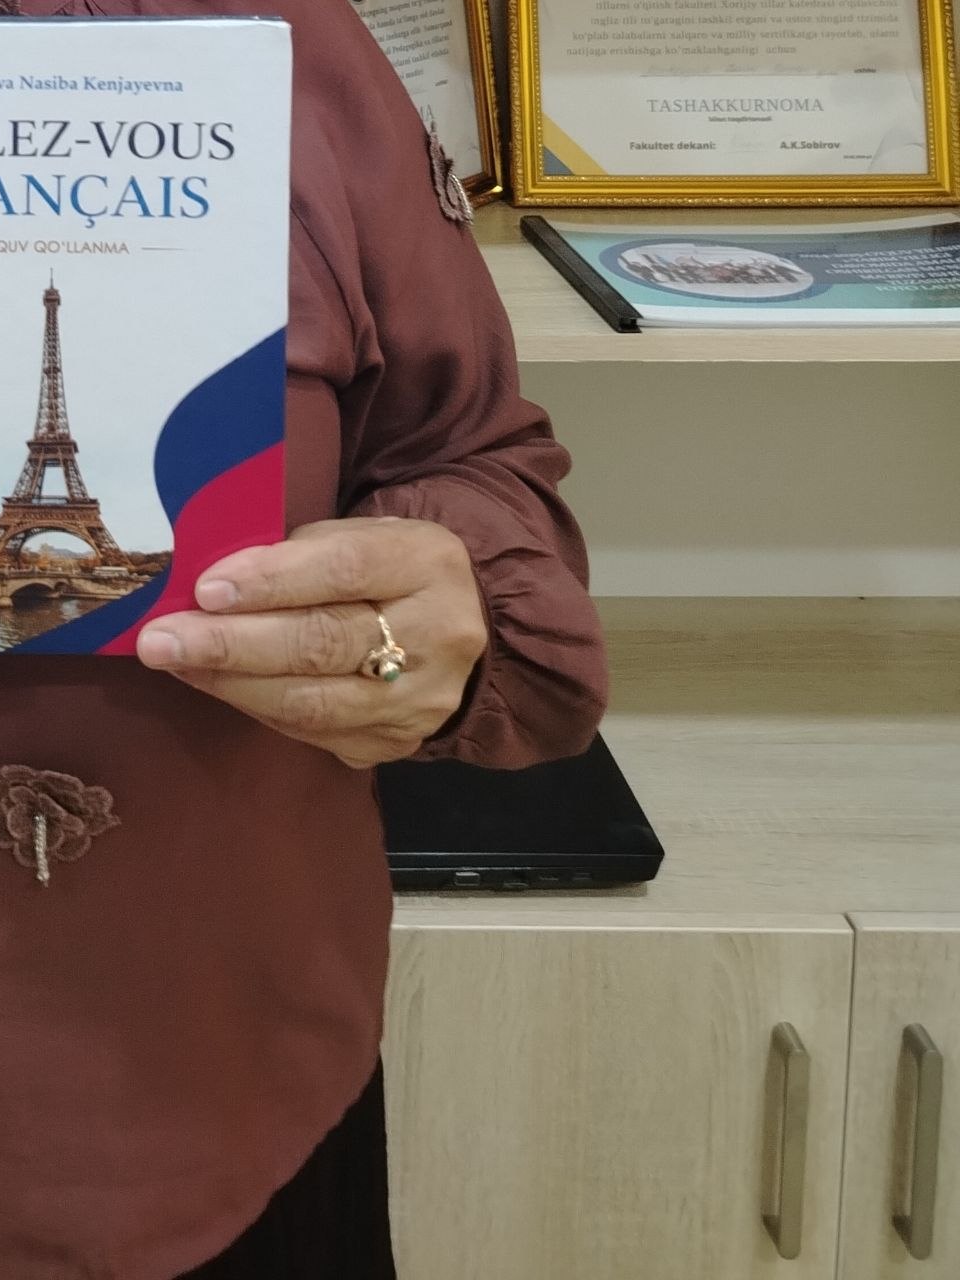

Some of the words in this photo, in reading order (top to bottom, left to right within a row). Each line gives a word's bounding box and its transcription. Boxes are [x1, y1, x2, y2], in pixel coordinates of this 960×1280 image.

[19, 75, 79, 91] Nasiba
[83, 76, 184, 95] Kenjayevna
[646, 98, 825, 113] TASHAKKURNOMA
[630, 141, 675, 151] Fakultet
[677, 140, 717, 150] dekani:
